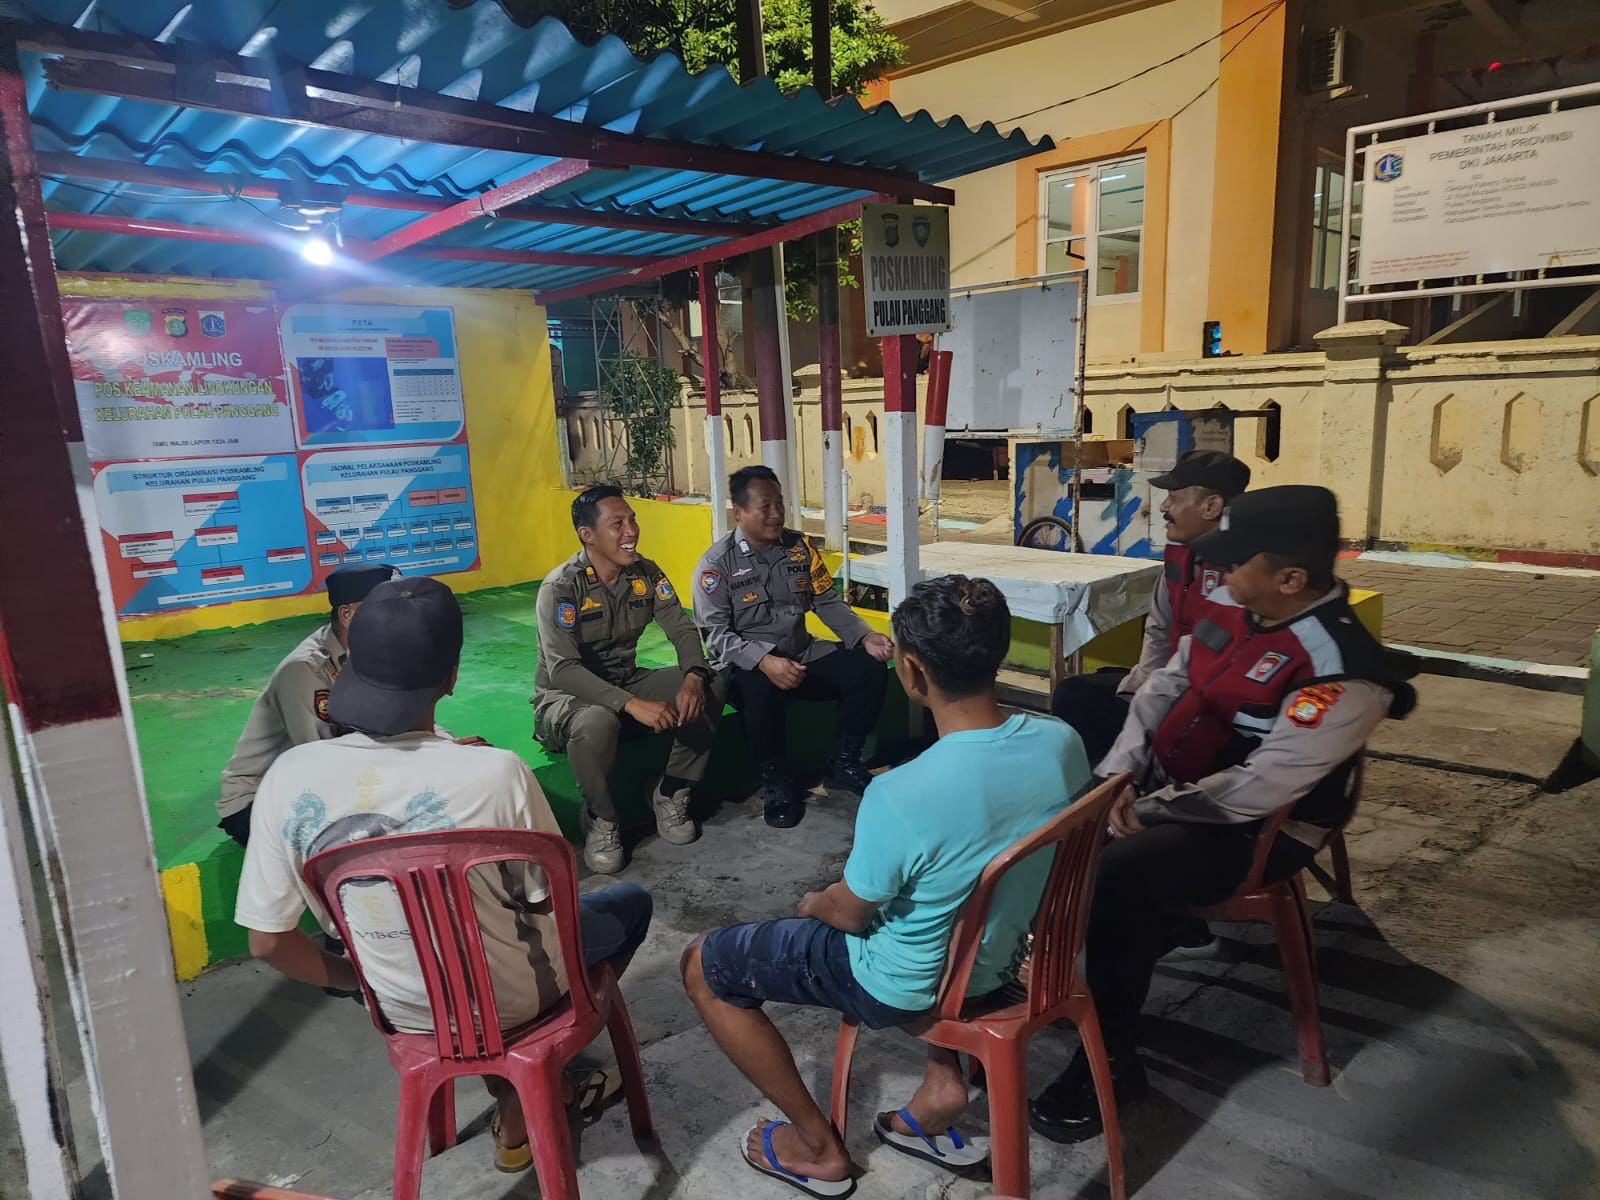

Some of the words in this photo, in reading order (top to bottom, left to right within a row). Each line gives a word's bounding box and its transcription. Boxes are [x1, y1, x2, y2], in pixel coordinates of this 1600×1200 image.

[1462, 131, 1502, 144] TANAH
[1430, 143, 1507, 161] PEMERINTAH
[1511, 131, 1574, 148] PROVINSI
[1459, 159, 1479, 170] DKI
[1482, 150, 1538, 167] JAKARTA
[871, 255, 946, 292] POSKAMLING
[874, 300, 900, 327] PULAU
[902, 298, 946, 325] PANGGANG
[95, 382, 122, 398] POS
[123, 380, 194, 397] KEAMANAN
[194, 380, 274, 396] LINGKUNGAN
[95, 406, 173, 422] KELURAHAN
[174, 404, 213, 419] PULAU
[216, 403, 280, 418] PANGGANG
[330, 463, 355, 472] JADWAL
[356, 460, 402, 470] PELAKSANAAN
[403, 458, 442, 467] POSKAMLING
[340, 470, 379, 478] KELURAHAN
[379, 468, 400, 476] PULAU
[400, 465, 435, 475] PANGGANG
[133, 472, 173, 480] STRUKTUR
[175, 468, 219, 478] ORGANISASI
[220, 466, 265, 475] POSKAMLING
[145, 478, 190, 487] KELURAHAN
[192, 476, 216, 485] PULAU
[217, 474, 256, 483] PANGGANG
[787, 564, 809, 574] POL
[354, 929, 411, 940] VIBES
